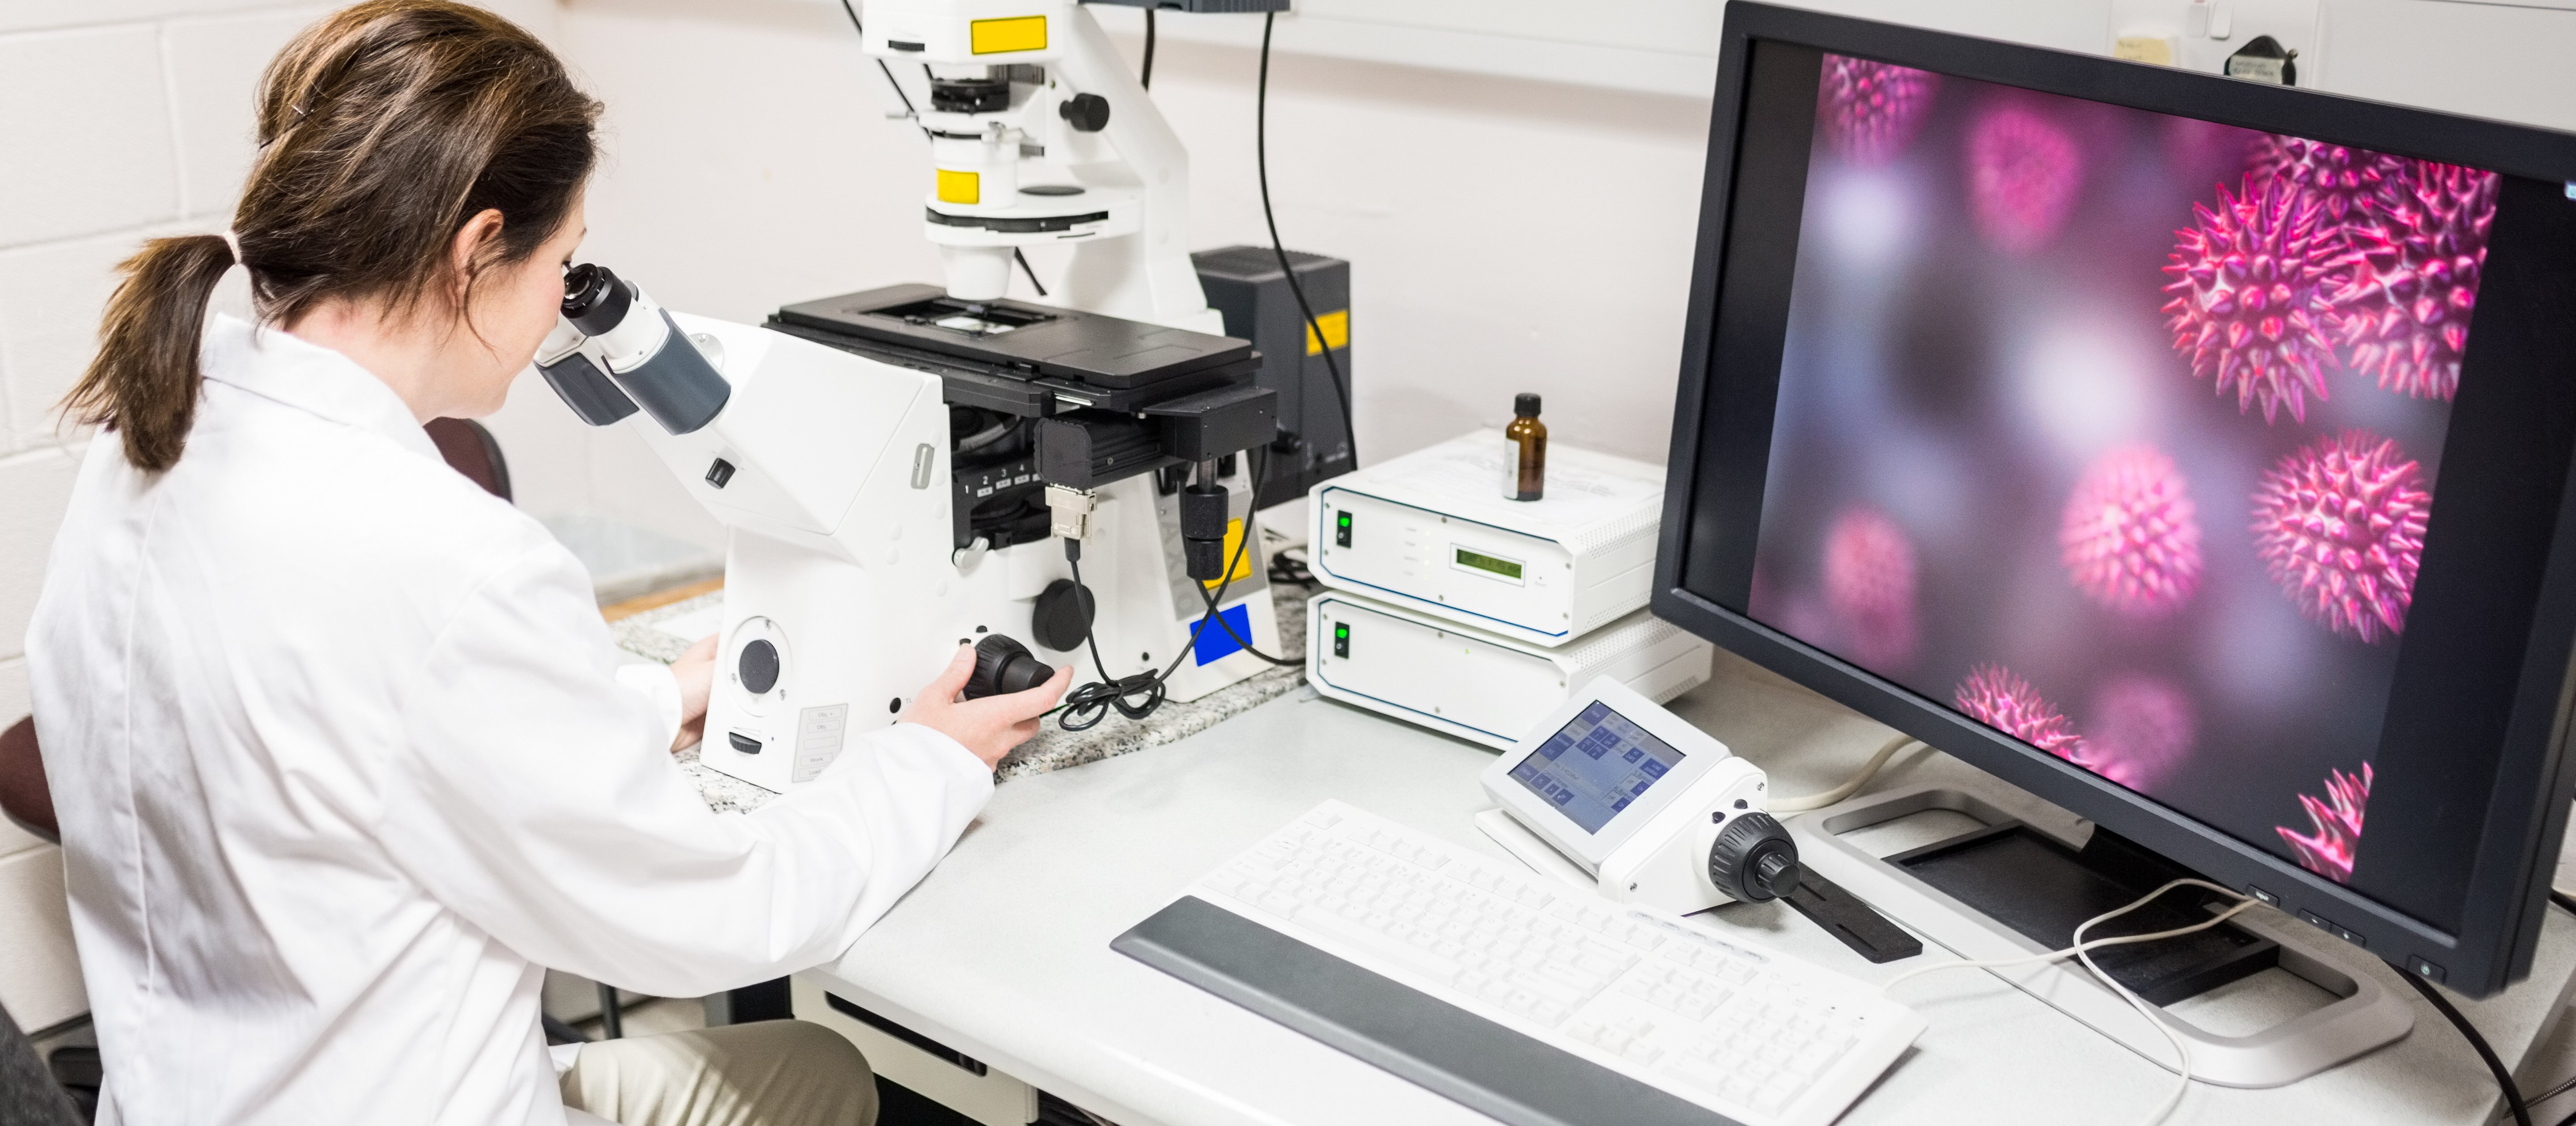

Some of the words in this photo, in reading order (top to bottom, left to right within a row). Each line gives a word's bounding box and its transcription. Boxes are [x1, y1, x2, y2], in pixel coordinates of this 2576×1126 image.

[1019, 463, 1025, 472] 4
[1001, 468, 1007, 477] 3
[983, 475, 988, 485] 2
[965, 485, 969, 494] 1
